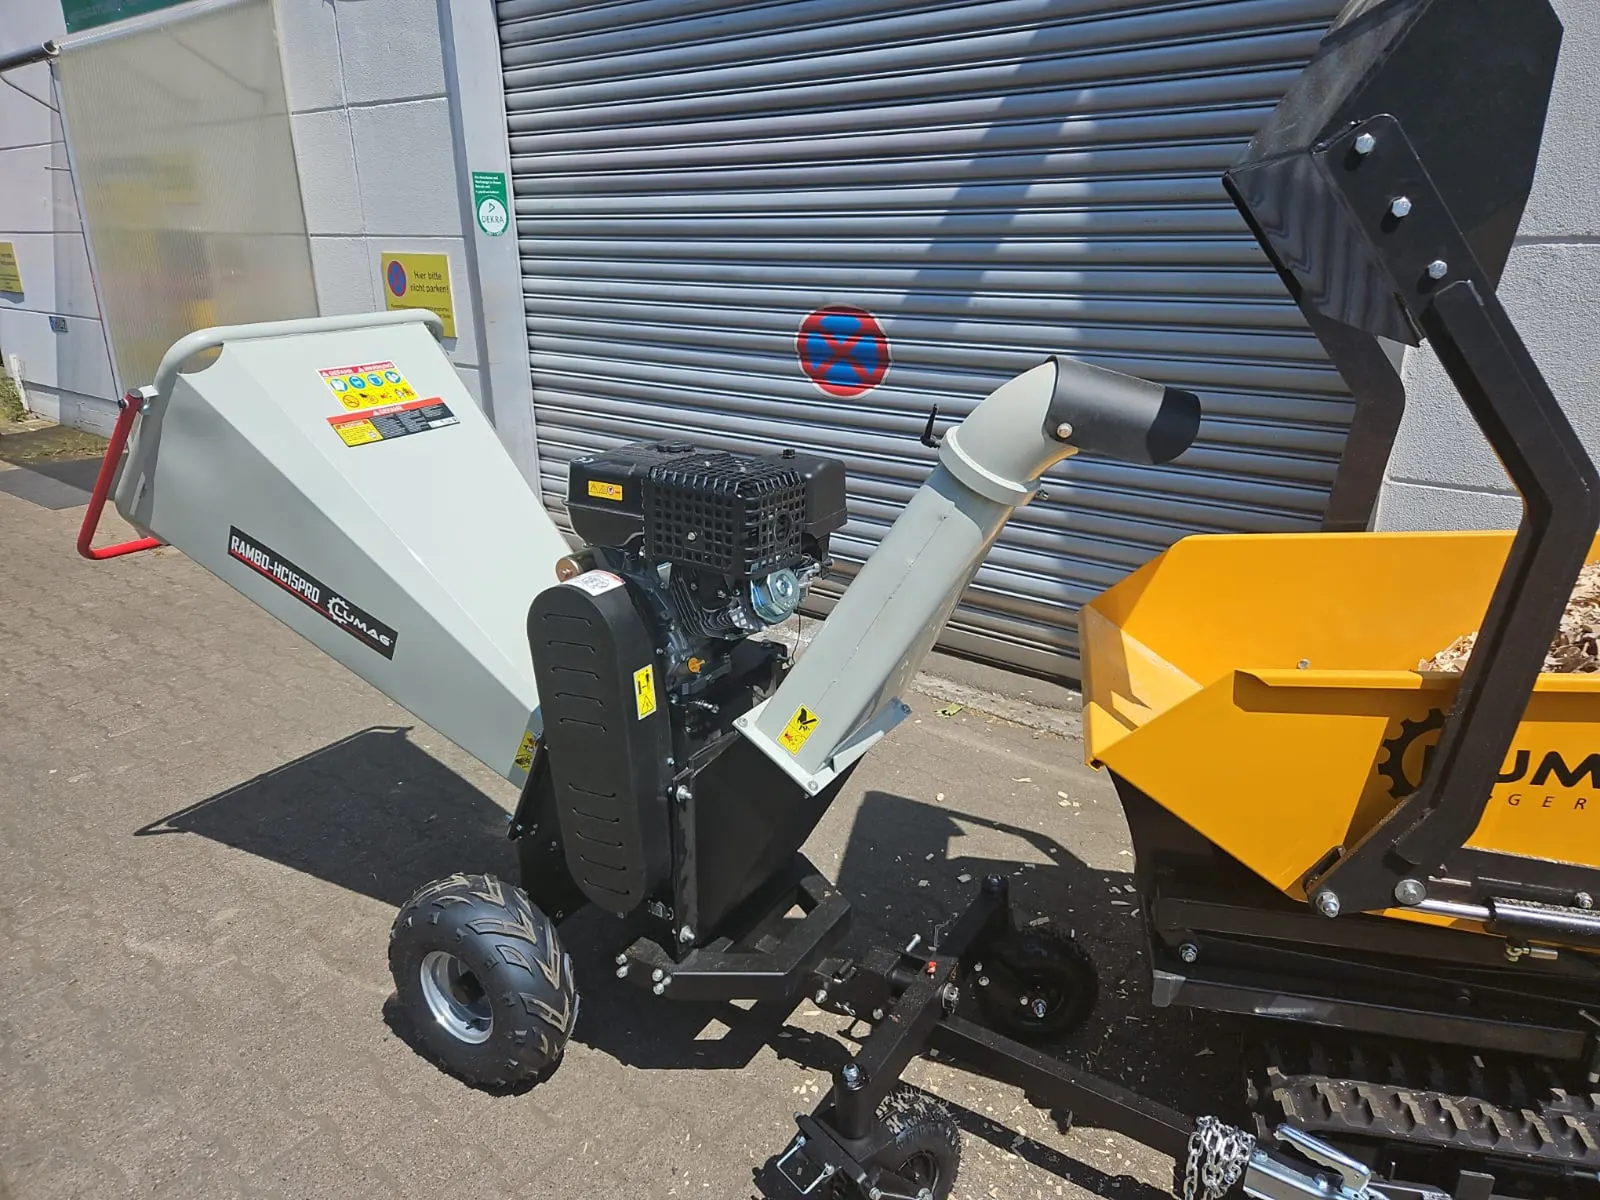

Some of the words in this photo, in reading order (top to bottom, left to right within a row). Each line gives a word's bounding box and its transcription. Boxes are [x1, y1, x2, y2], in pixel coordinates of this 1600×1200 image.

[482, 215, 504, 223] DEKRA
[414, 270, 426, 279] Hier
[428, 272, 442, 280] bitte
[410, 283, 425, 291] nicht
[427, 284, 449, 294] parken!
[231, 535, 320, 604] RAMBO-HC15PRO
[333, 604, 391, 647] LUMAG
